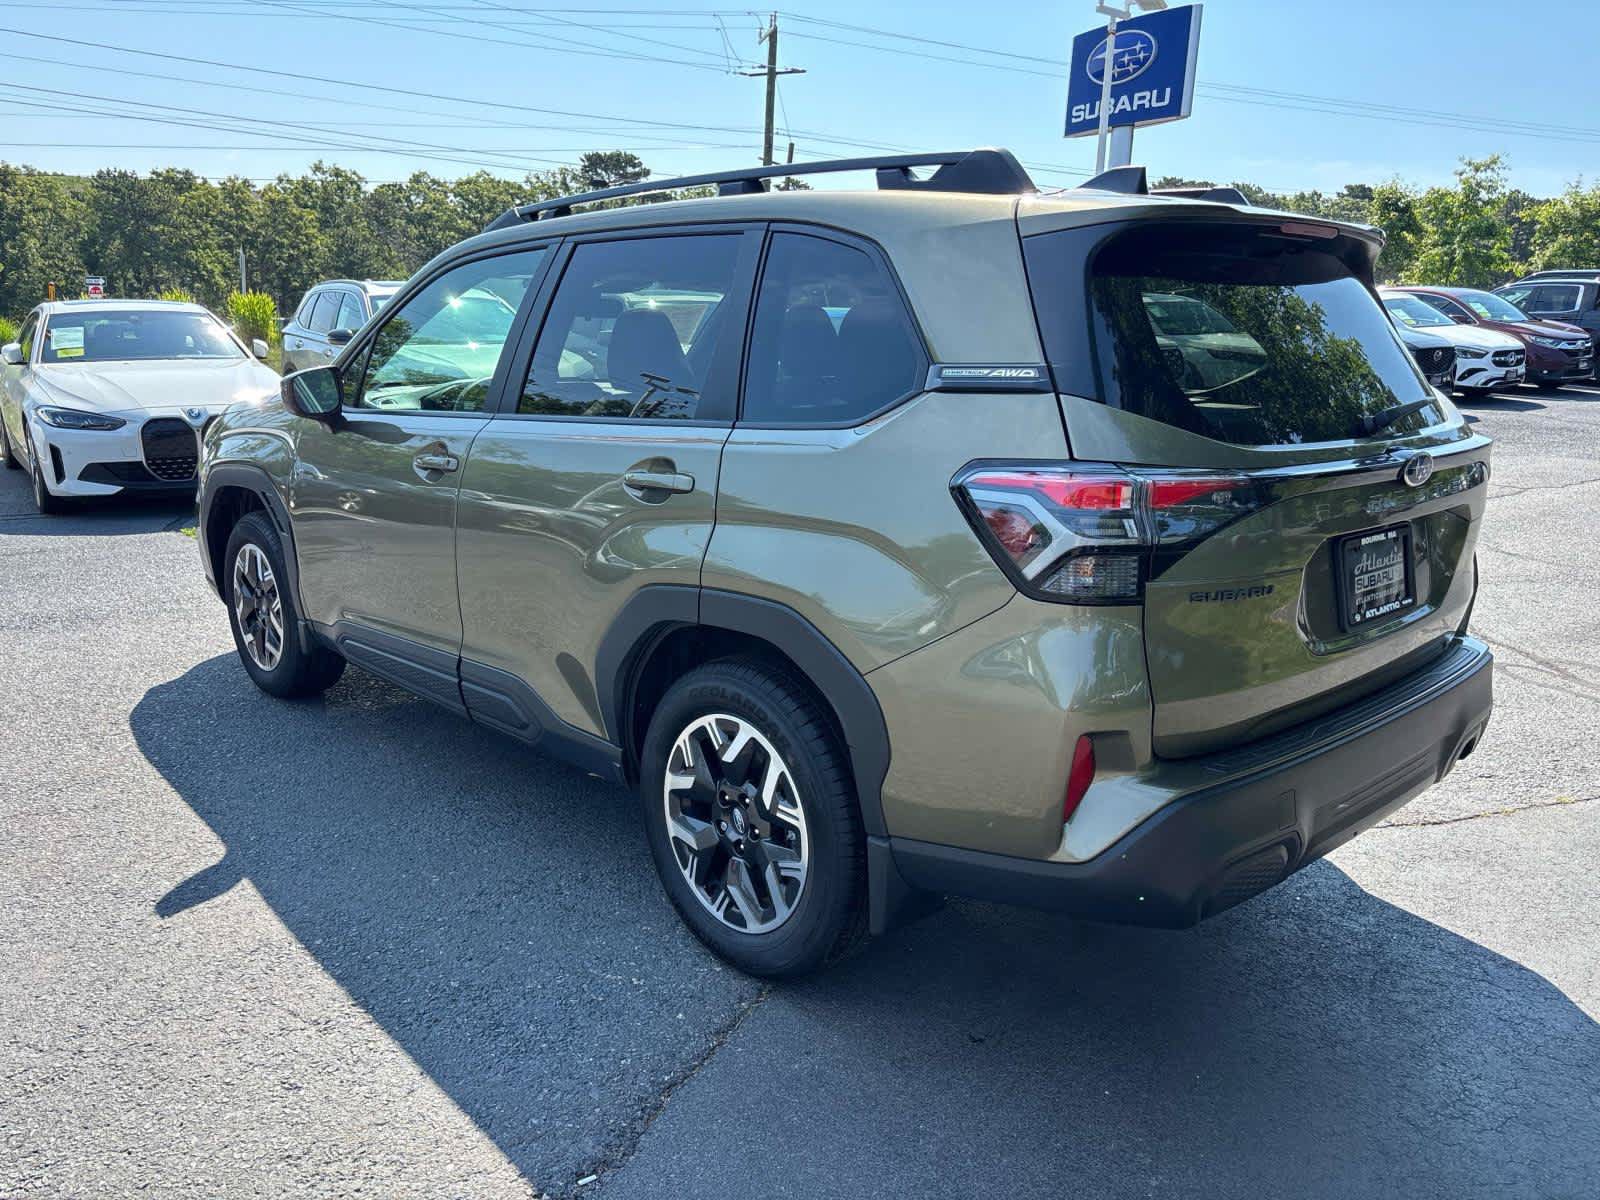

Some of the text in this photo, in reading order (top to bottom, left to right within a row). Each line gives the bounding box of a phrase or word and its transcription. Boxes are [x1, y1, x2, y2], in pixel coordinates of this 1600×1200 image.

[988, 368, 1037, 378] AWD
[1354, 545, 1404, 576] Atlantic
[1356, 567, 1395, 590] SUBARU
[1190, 584, 1275, 603] SUBARU
[1366, 600, 1401, 618] ATLANTIC
